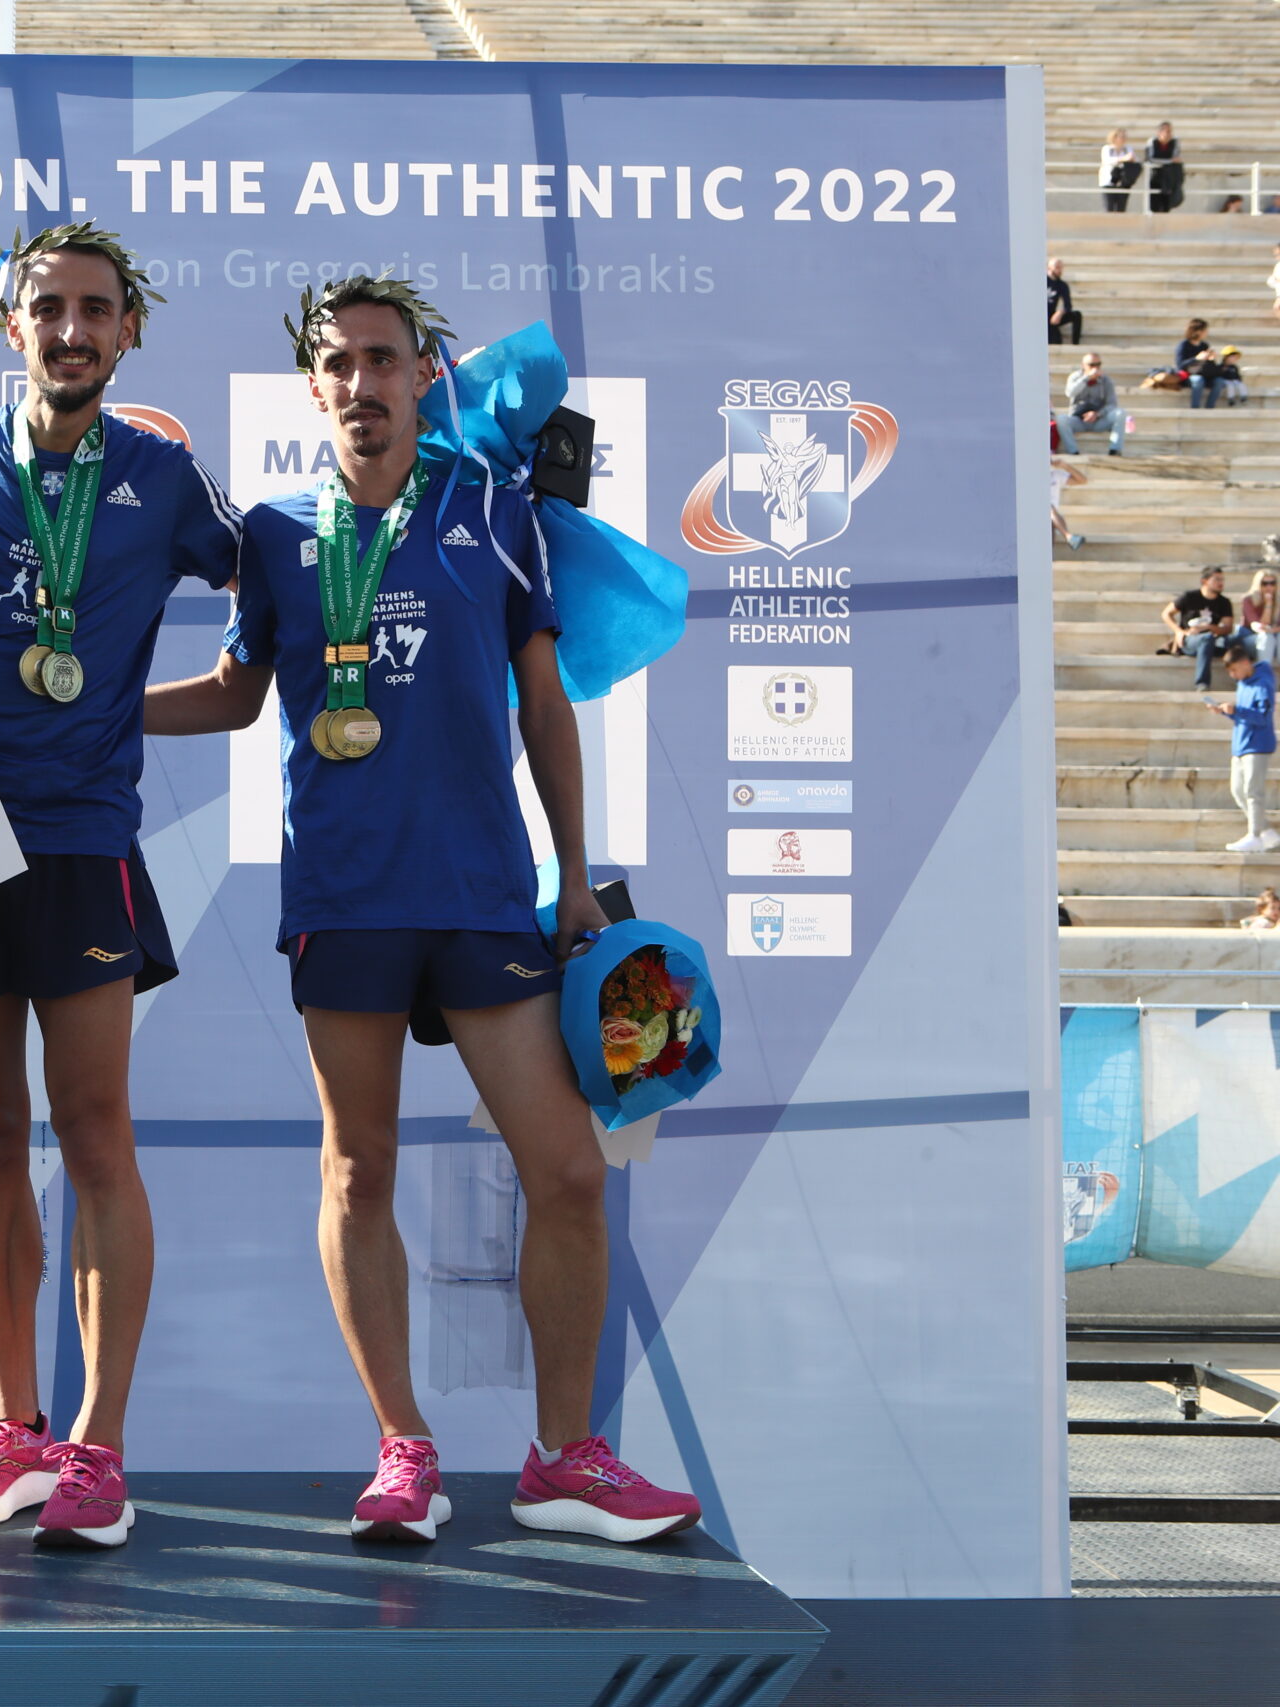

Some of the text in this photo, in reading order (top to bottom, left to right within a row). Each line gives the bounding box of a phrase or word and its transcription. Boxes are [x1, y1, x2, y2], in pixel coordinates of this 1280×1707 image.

[116, 159, 266, 214] THE
[293, 161, 745, 221] AUTHENTIC
[773, 167, 958, 223] 2022
[461, 251, 716, 295] Lambrakis
[725, 379, 851, 408] SEGAS
[68, 467, 79, 504] AUTHENTIC
[83, 465, 96, 502] AUTHENTIC
[65, 502, 73, 516] THE
[79, 502, 88, 516] THE
[106, 495, 142, 507] adidas
[442, 536, 479, 547] adidas
[8, 552, 24, 562] THE
[368, 562, 377, 576] THE
[374, 525, 389, 561] AUTHENTIC
[67, 558, 78, 583] ATHENS
[728, 566, 851, 589] HELLENIC
[372, 600, 426, 614] ARATHON
[728, 595, 850, 618] ATHLETICS
[381, 611, 427, 621] AUTHENTIC
[729, 624, 851, 644] FEDERATION
[385, 672, 415, 687] opap
[733, 736, 846, 745] HELLENIC REPUBLIC
[733, 747, 846, 756] REGION OF ATTICA
